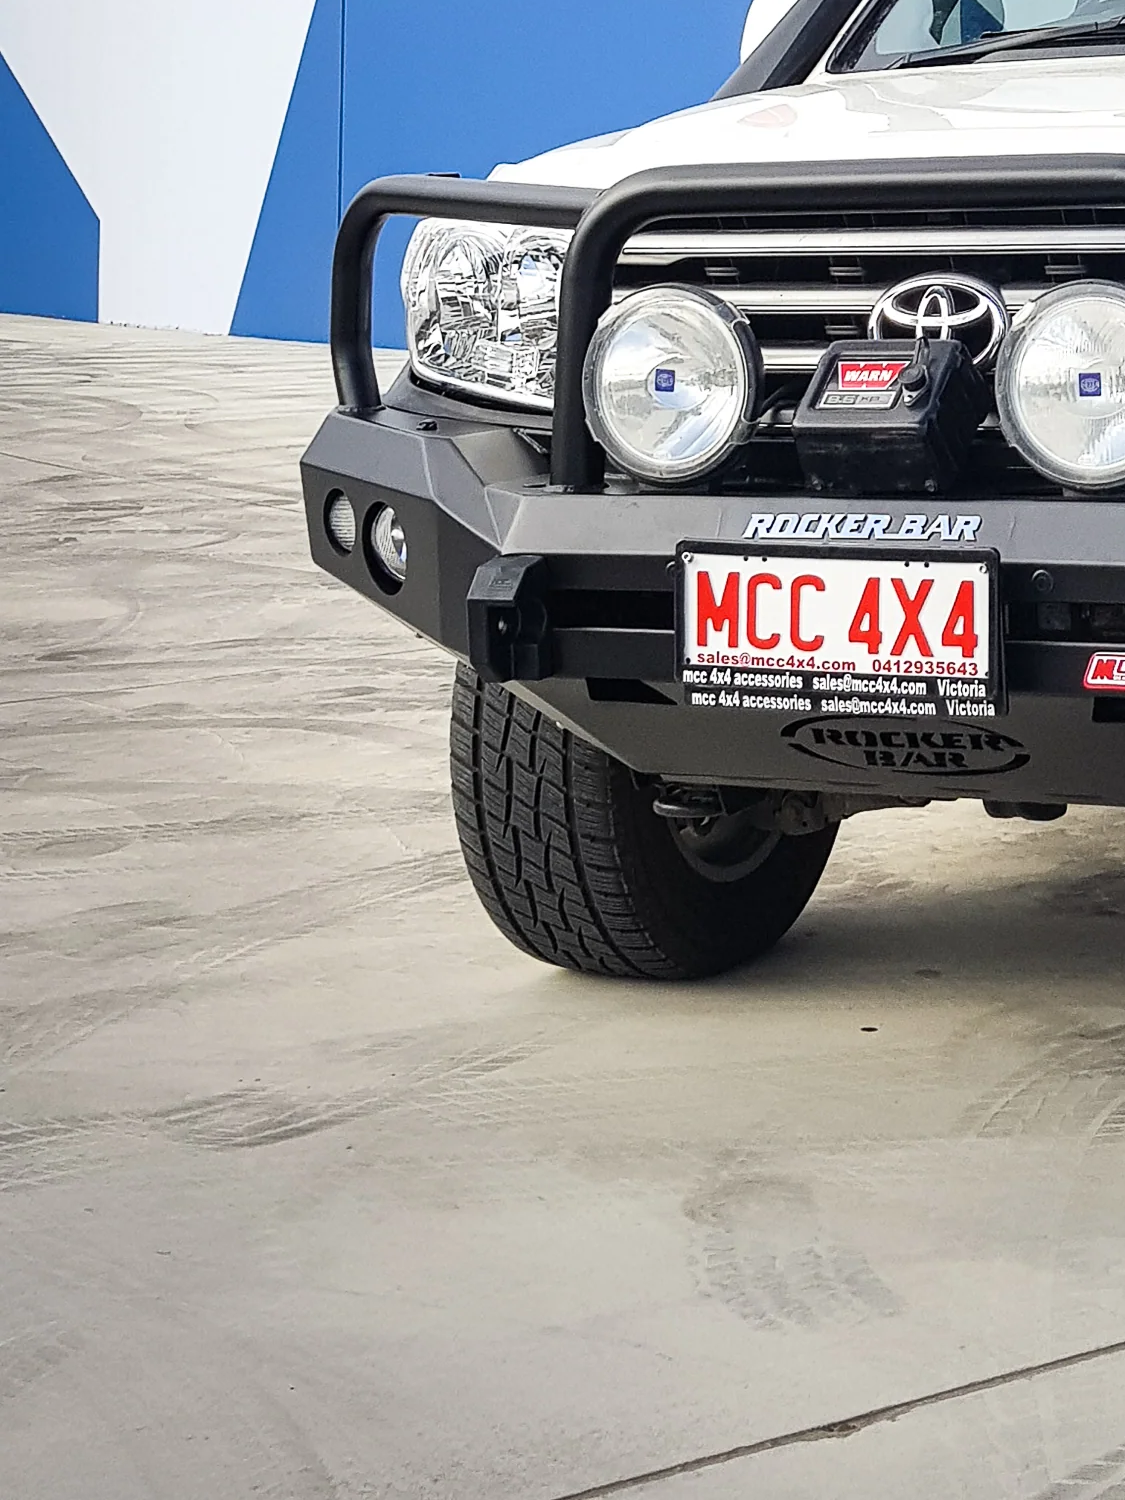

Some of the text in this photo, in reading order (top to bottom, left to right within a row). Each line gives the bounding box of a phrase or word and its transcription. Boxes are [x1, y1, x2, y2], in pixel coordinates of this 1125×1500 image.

[844, 369, 892, 382] WARN
[743, 513, 982, 541] ROCKER BAR
[697, 571, 979, 658] MCC 4X4
[697, 652, 978, 676] sales@mcc4x4.com 0412935643
[683, 670, 986, 698] mcc 4x4 accessories sales@mcc4x4.com Victoria
[692, 691, 996, 716] mcc 4x4 accessories sales@mcc4x4.com Victoria
[811, 728, 1004, 751] ROCKER
[864, 750, 969, 768] BAR
